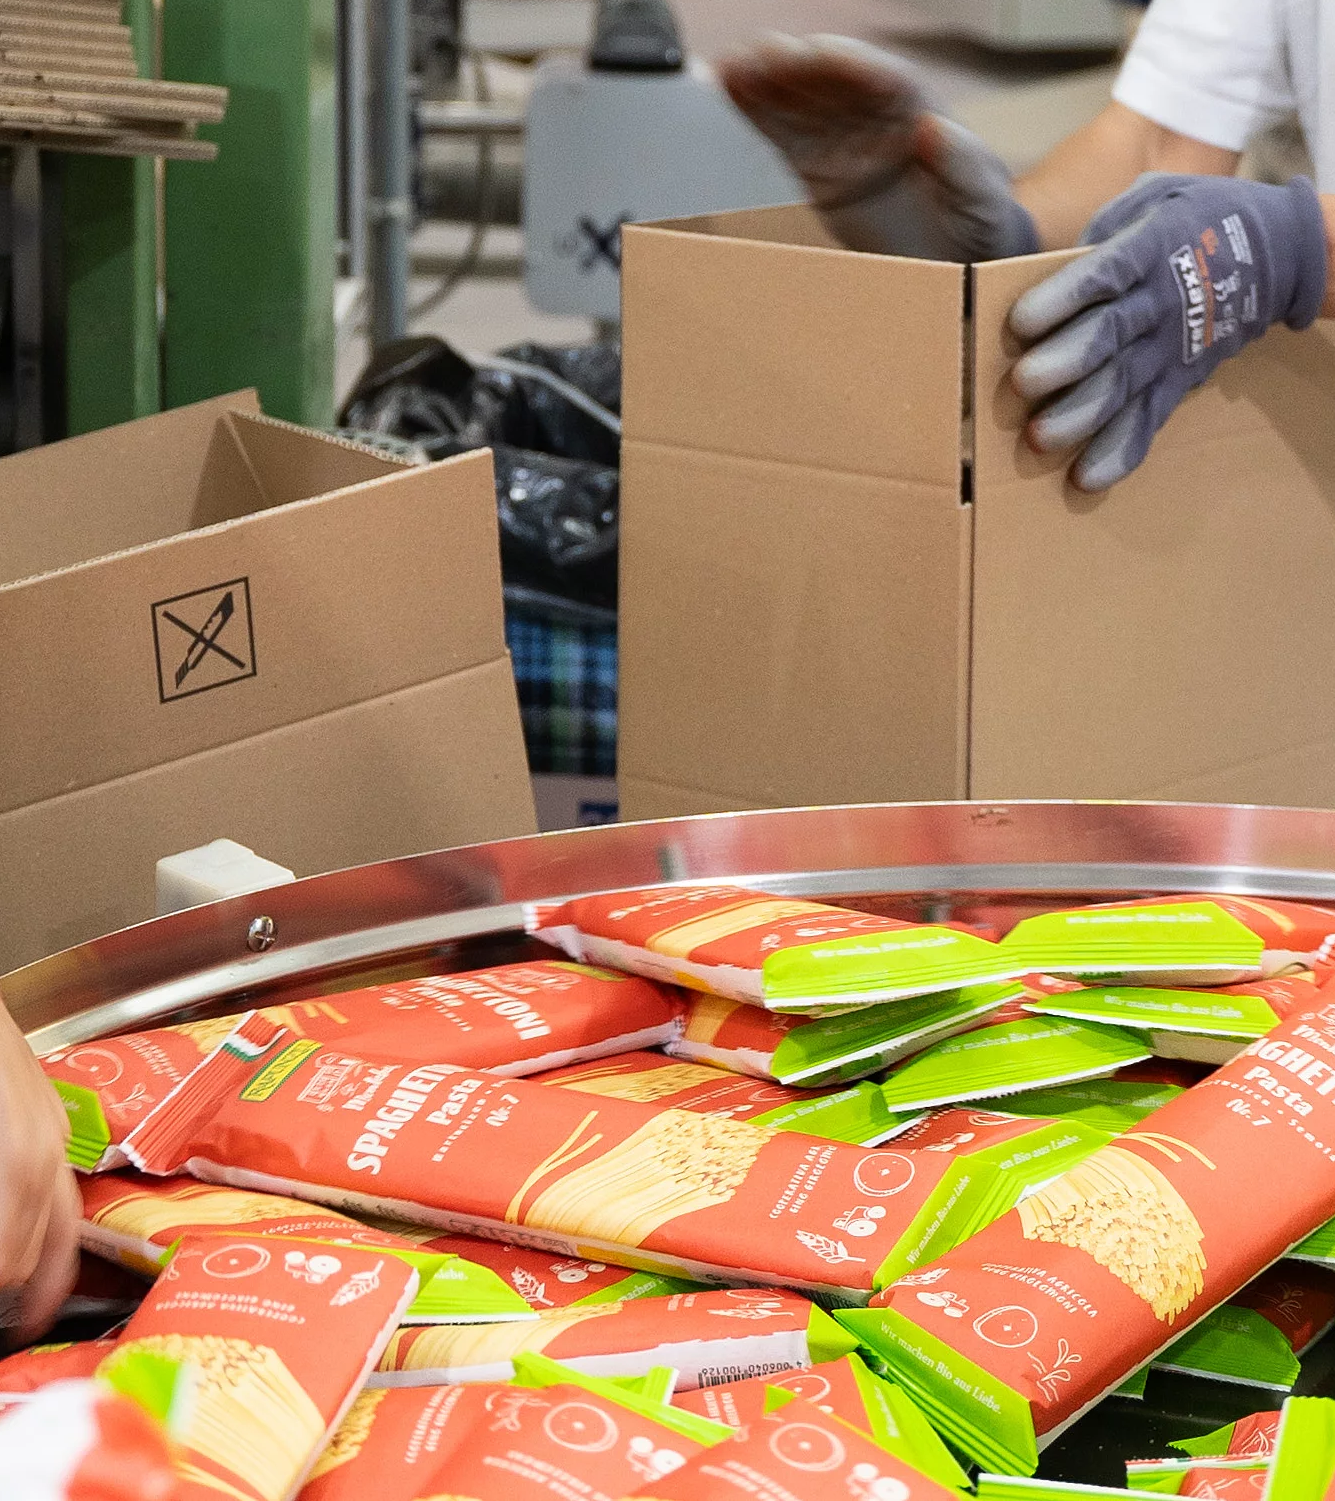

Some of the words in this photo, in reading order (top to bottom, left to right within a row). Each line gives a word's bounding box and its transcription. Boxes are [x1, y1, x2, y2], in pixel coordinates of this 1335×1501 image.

[425, 1078, 485, 1126] Pasta
[1243, 1065, 1313, 1116] Pasta
[1226, 1099, 1252, 1119] Nr.
[1251, 1114, 1273, 1126] 7
[1013, 1152, 1032, 1165] Bio
[789, 1194, 809, 1215] GINO
[906, 1246, 922, 1265] Wir
[919, 1219, 940, 1253] machen
[1047, 1276, 1098, 1318] AGRICOLA
[701, 1364, 741, 1375] 100126
[880, 1321, 897, 1340] Wir
[897, 1338, 940, 1367] machen
[935, 1361, 953, 1380] Bio
[953, 1376, 972, 1394] aus
[972, 1386, 1002, 1415] Liebe.
